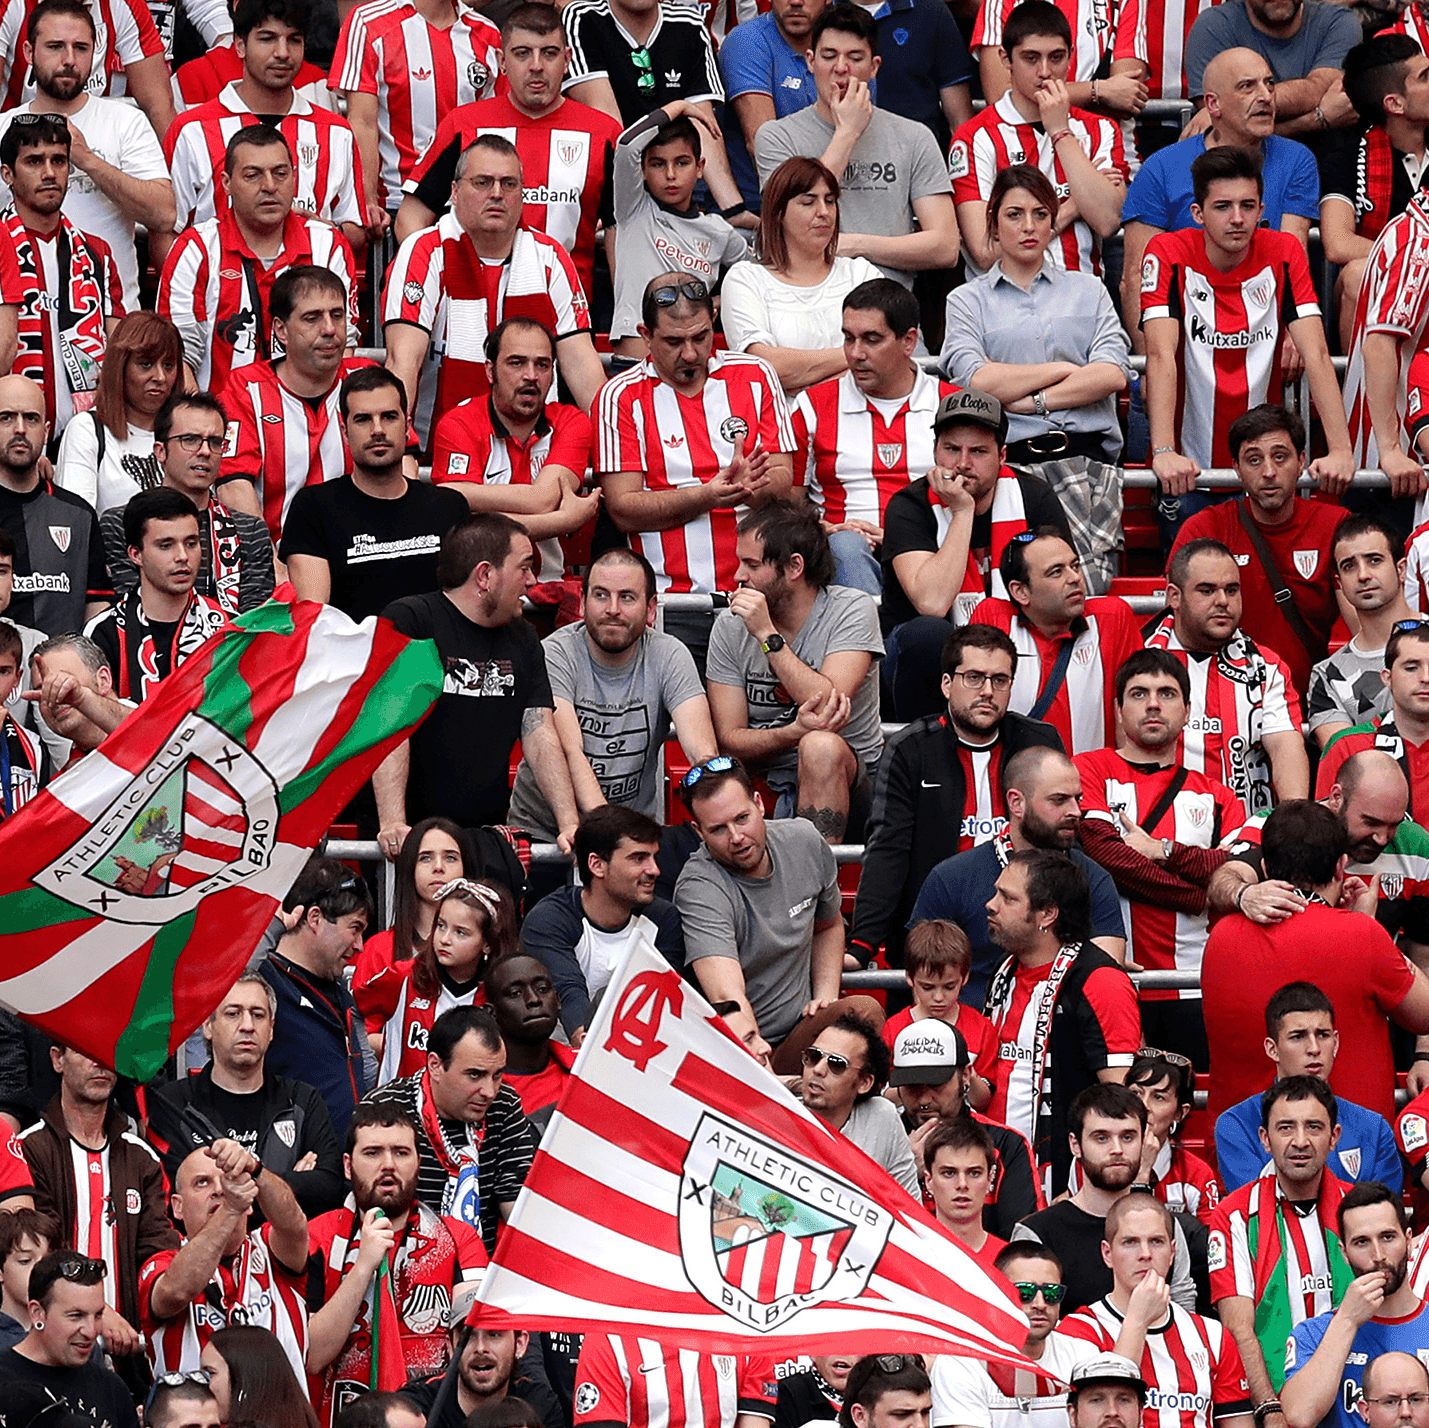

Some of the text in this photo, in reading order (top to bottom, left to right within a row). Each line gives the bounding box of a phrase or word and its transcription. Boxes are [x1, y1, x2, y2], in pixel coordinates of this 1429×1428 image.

[1190, 315, 1274, 348] Kutxabank
[12, 573, 70, 592] txabank
[54, 726, 197, 885] ATHLETIC CLUB
[707, 1129, 878, 1228] ATHLETIC CLUB
